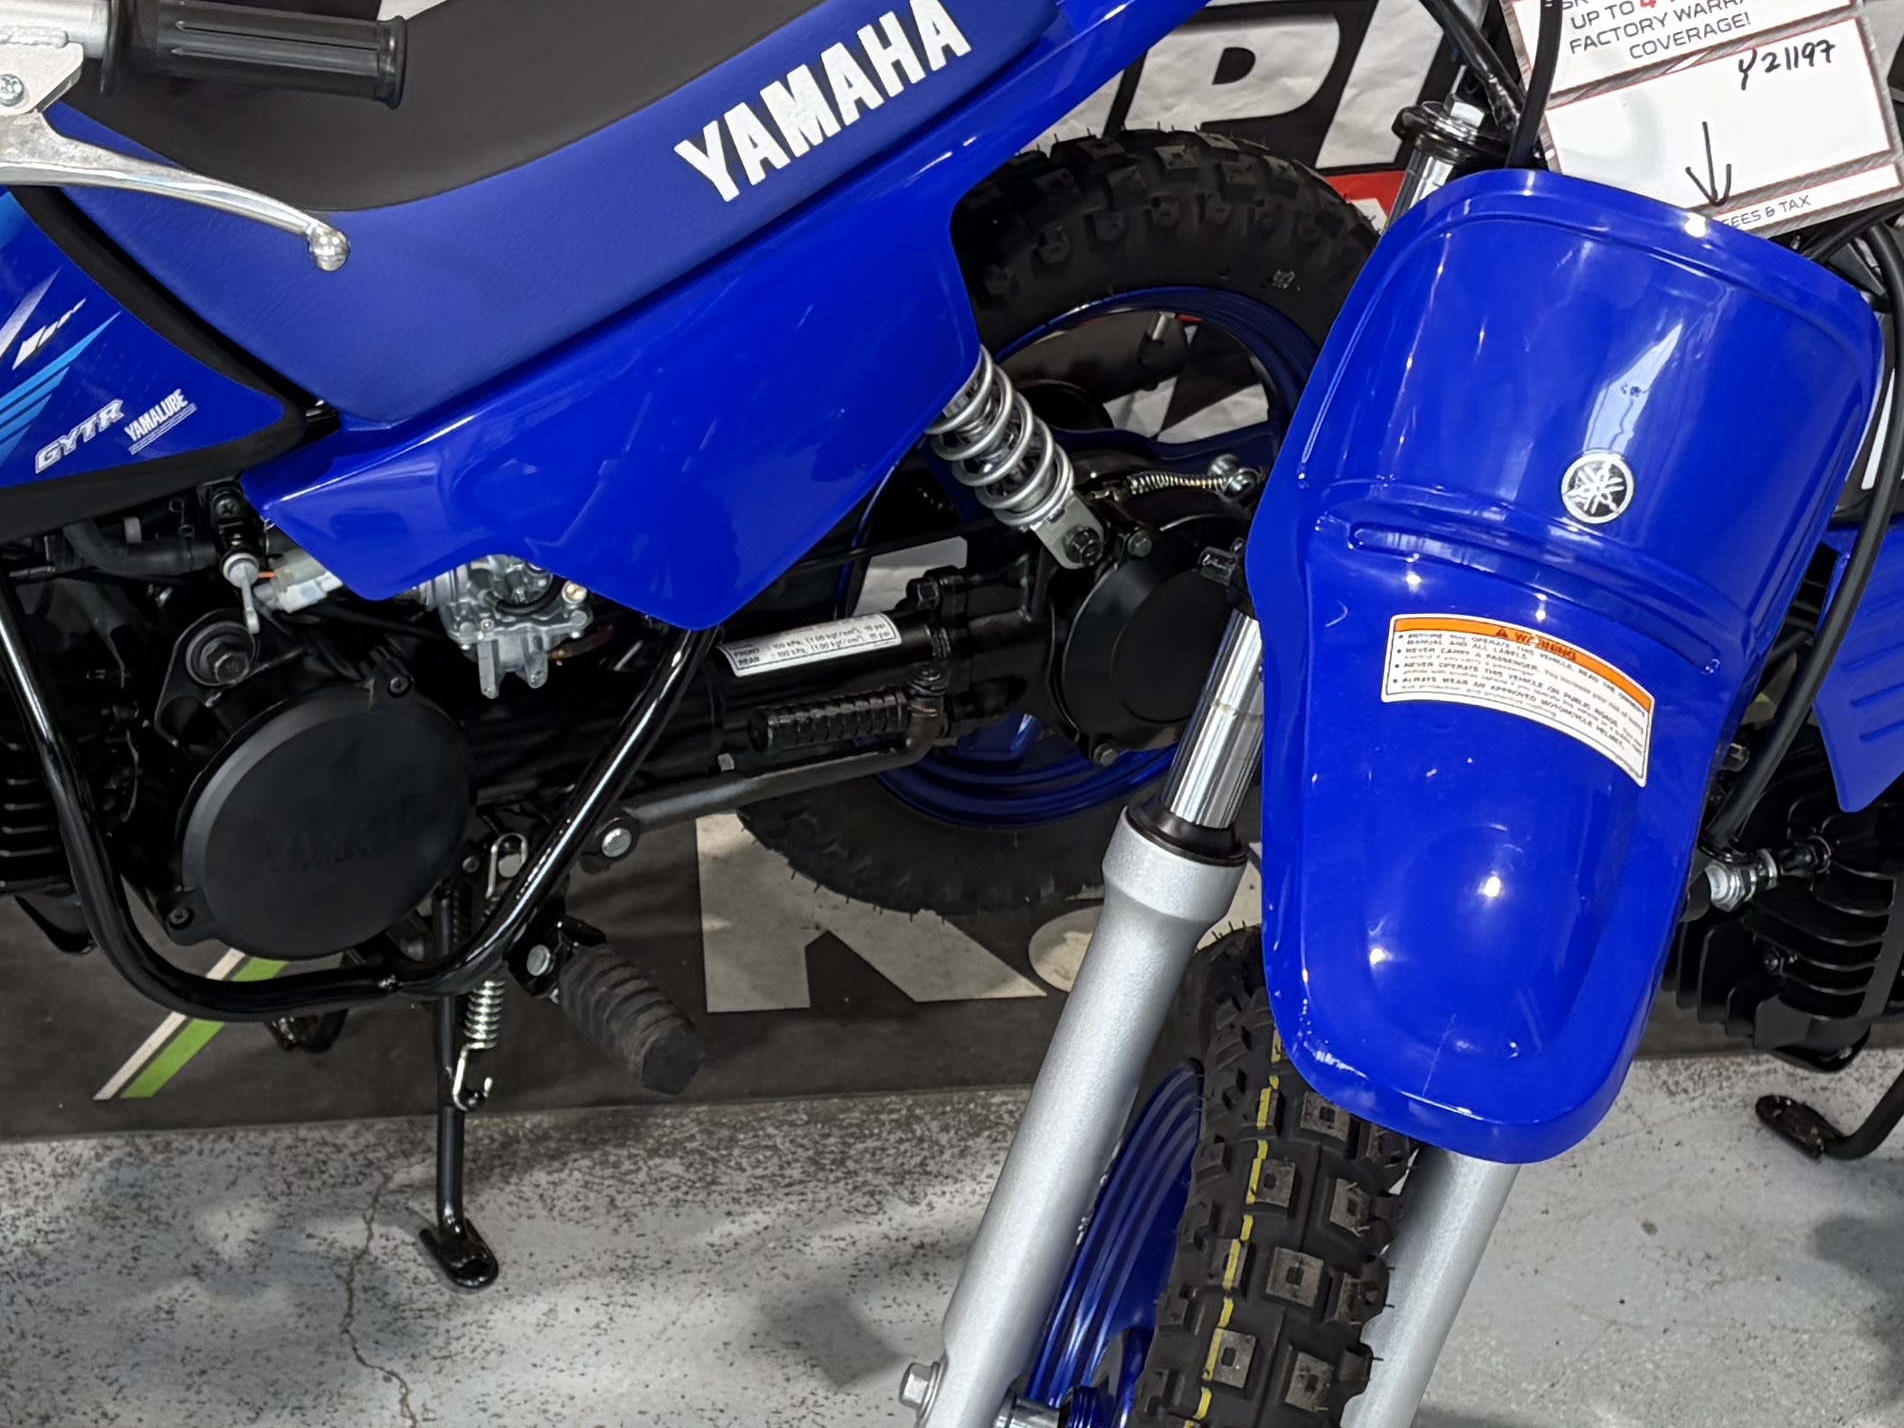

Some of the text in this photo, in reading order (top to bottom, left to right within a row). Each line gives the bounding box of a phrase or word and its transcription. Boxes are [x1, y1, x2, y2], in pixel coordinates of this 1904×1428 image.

[1569, 12, 1668, 54] FACTORY
[1570, 11, 1600, 31] UP
[1605, 1, 1635, 21] TO
[1629, 12, 1752, 59] COVERAGE!
[1778, 194, 1812, 213] TAX
[35, 398, 125, 474] GYTR
[124, 389, 189, 443] YAMALUBE
